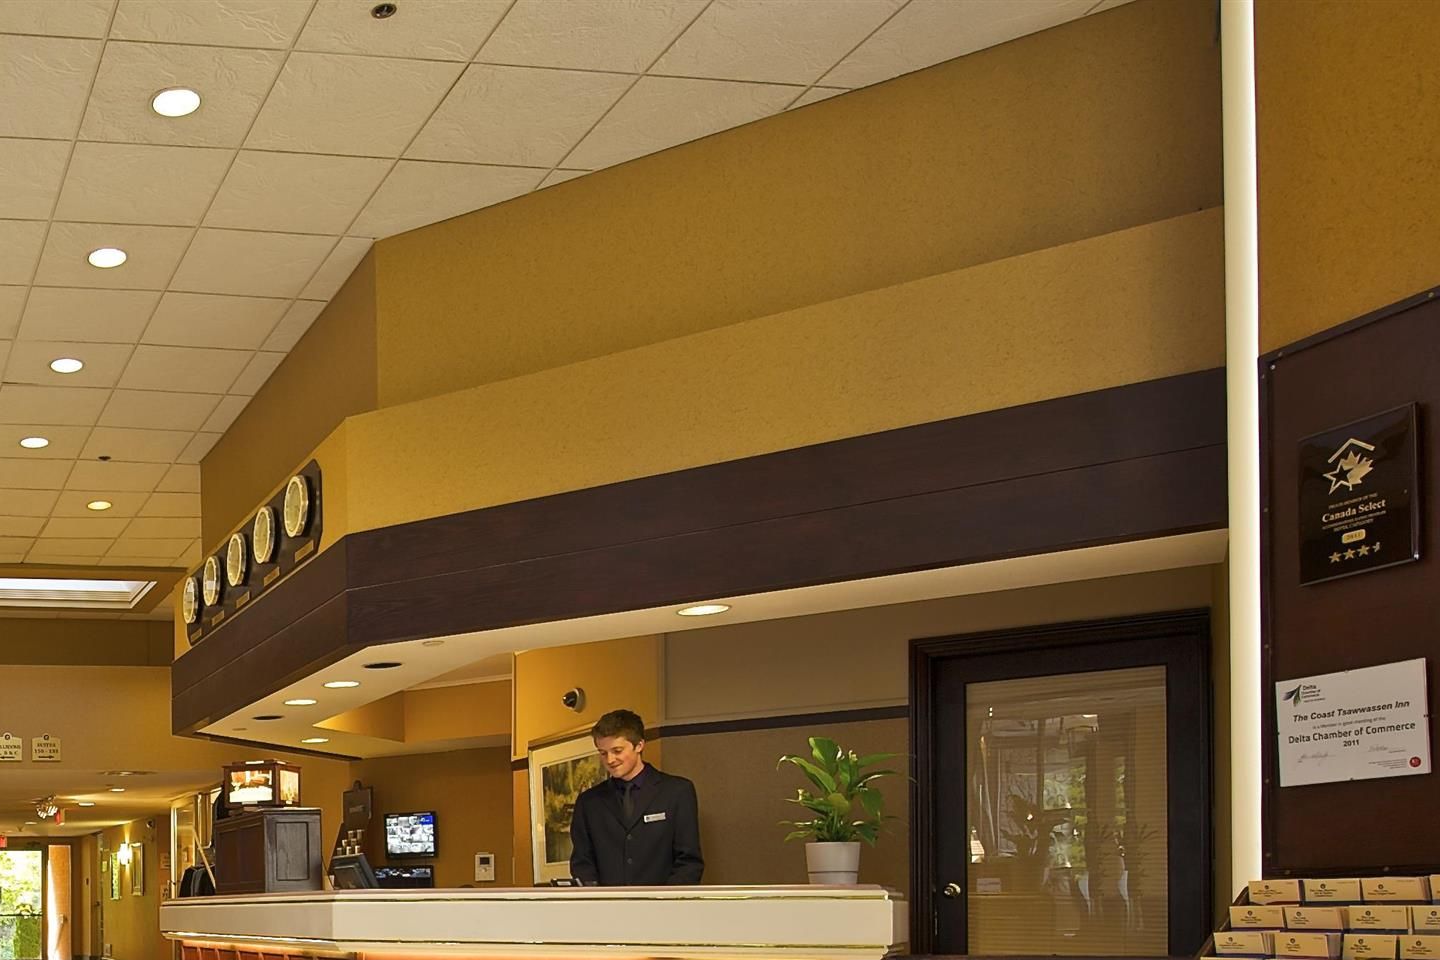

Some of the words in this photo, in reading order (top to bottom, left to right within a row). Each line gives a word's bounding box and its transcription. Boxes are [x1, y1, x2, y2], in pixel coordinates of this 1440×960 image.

[1322, 507, 1356, 522] Canada
[1358, 499, 1385, 513] Select
[1293, 714, 1308, 722] The
[1310, 711, 1335, 720] Coast
[1337, 703, 1392, 716] Tsawwassen
[1395, 701, 1410, 709] Inn
[1288, 734, 1311, 744] Delta
[1313, 730, 1352, 741] Chamber
[1354, 727, 1364, 736] of
[1366, 722, 1416, 735] Commerce
[1343, 739, 1359, 747] 2011
